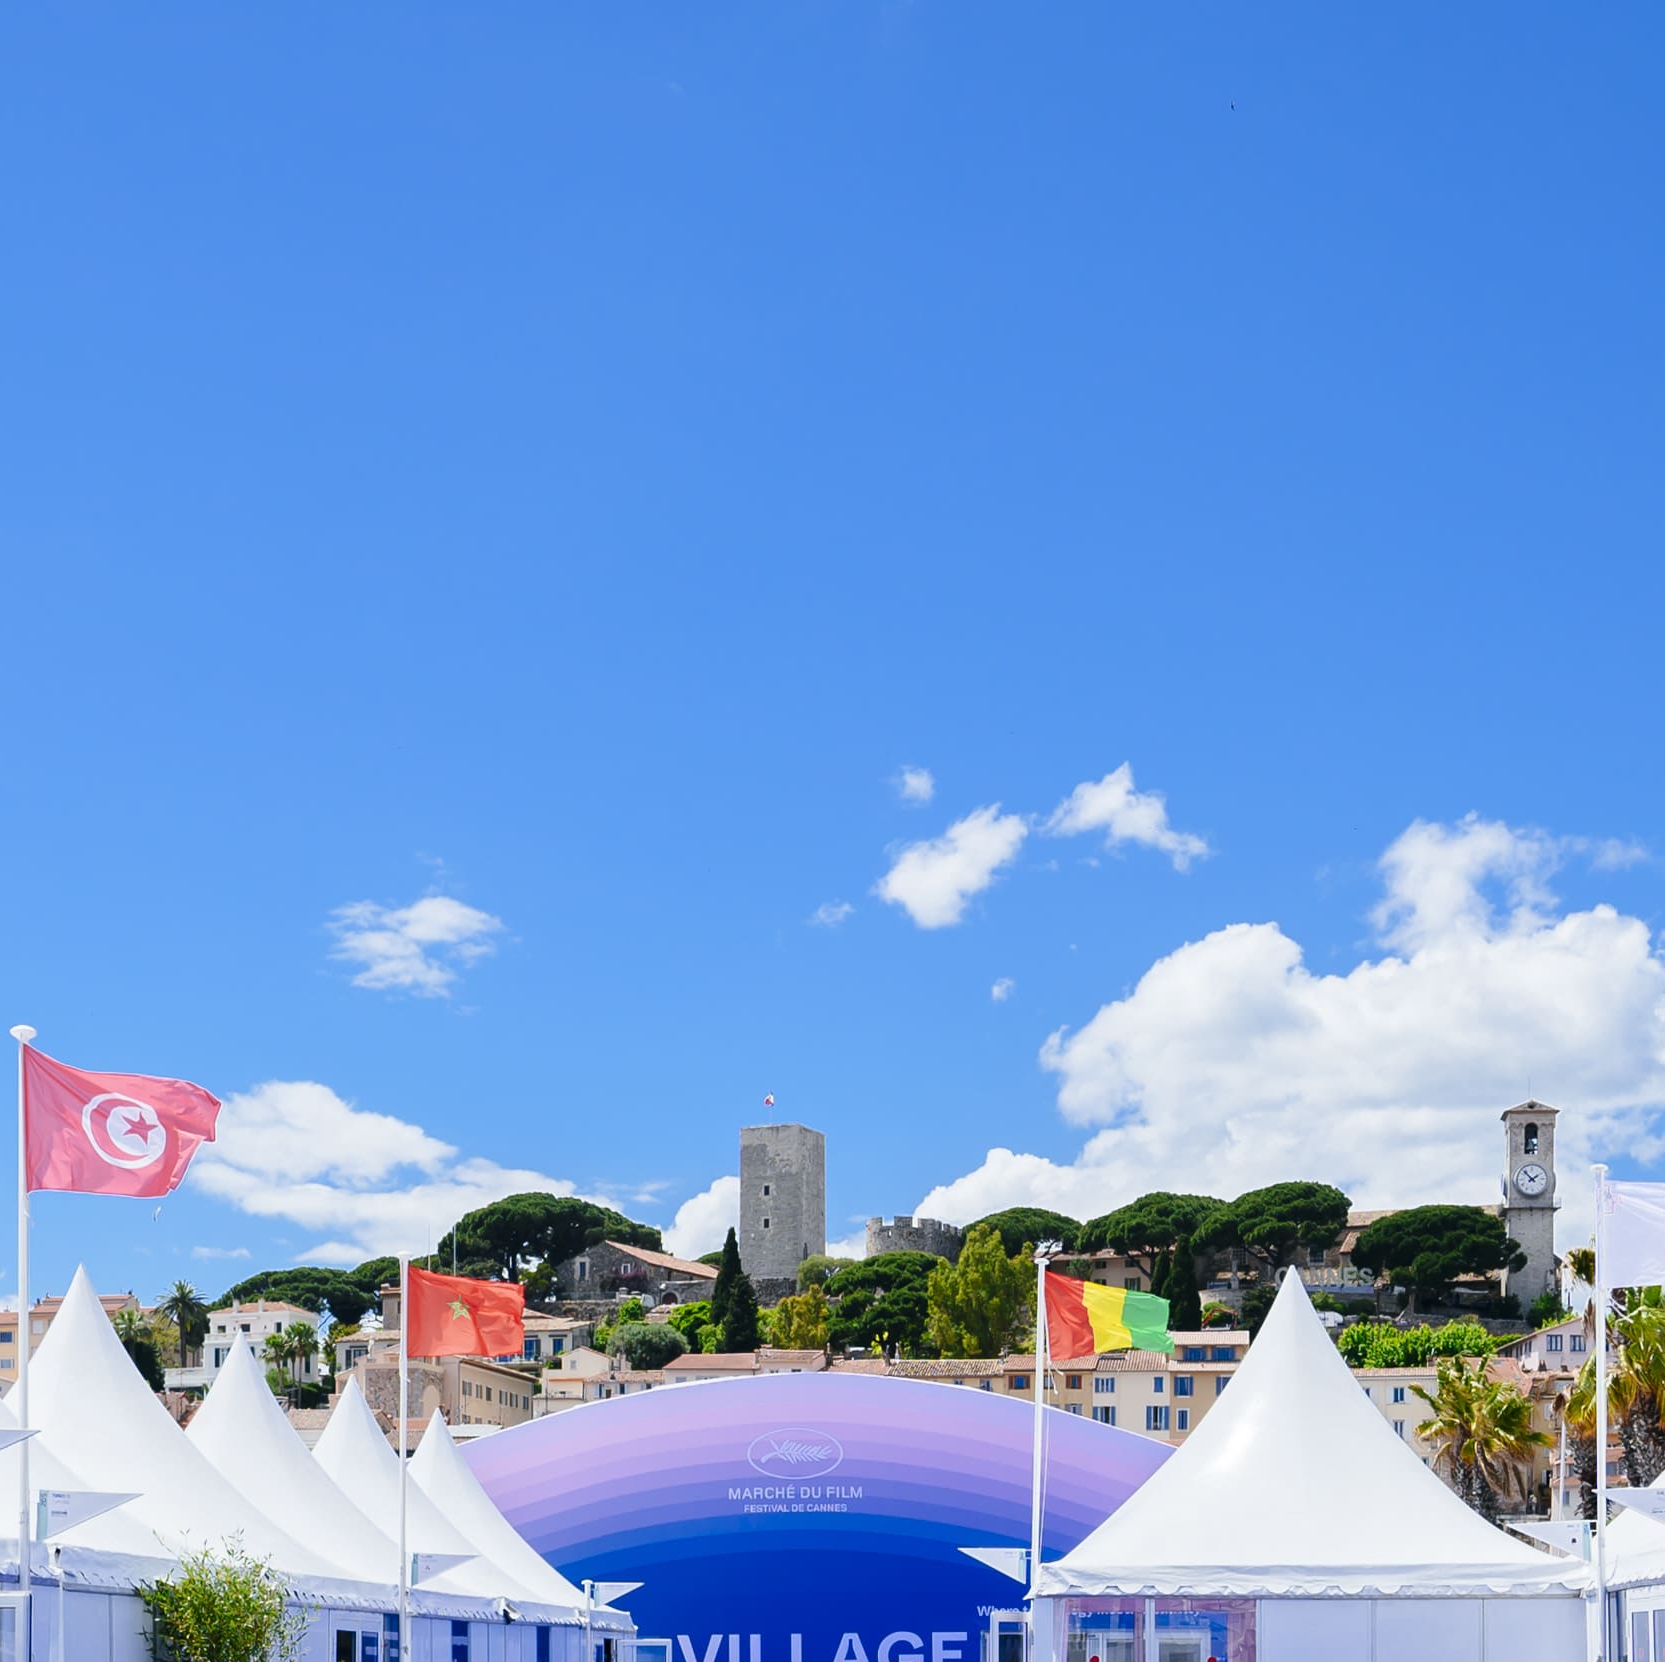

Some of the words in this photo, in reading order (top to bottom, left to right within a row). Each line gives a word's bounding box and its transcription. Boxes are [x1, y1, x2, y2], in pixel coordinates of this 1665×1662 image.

[727, 1484, 795, 1500] MARCHÉ
[800, 1486, 822, 1499] DU
[826, 1486, 863, 1499] FILM
[791, 1504, 805, 1513] DE
[807, 1503, 847, 1512] CANNES
